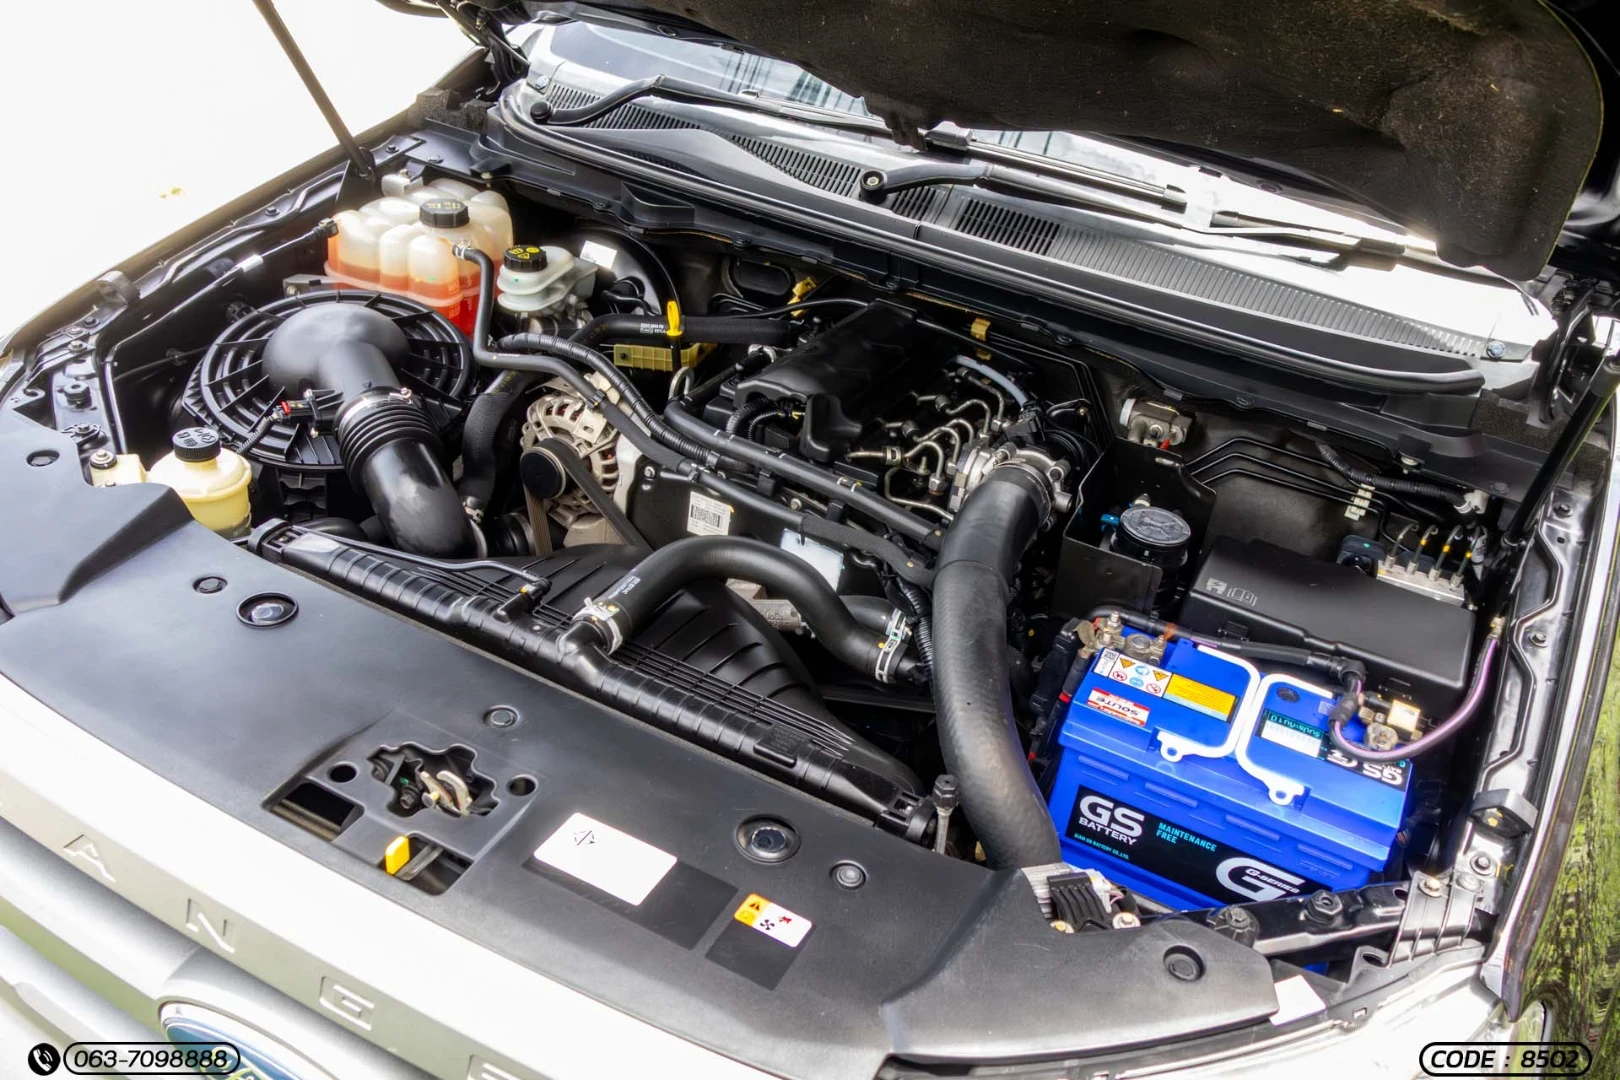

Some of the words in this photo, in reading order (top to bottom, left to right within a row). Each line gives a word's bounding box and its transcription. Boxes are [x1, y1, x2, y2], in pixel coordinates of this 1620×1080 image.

[1096, 696, 1139, 716] SOLITE
[1362, 762, 1403, 785] GS
[1080, 795, 1145, 838] GS
[1078, 816, 1137, 846] BATTERY
[1156, 830, 1179, 844] FREE
[1158, 822, 1217, 852] MAINTENANCE
[1093, 840, 1112, 852] BATTERY
[1245, 868, 1300, 894] G-SERIES
